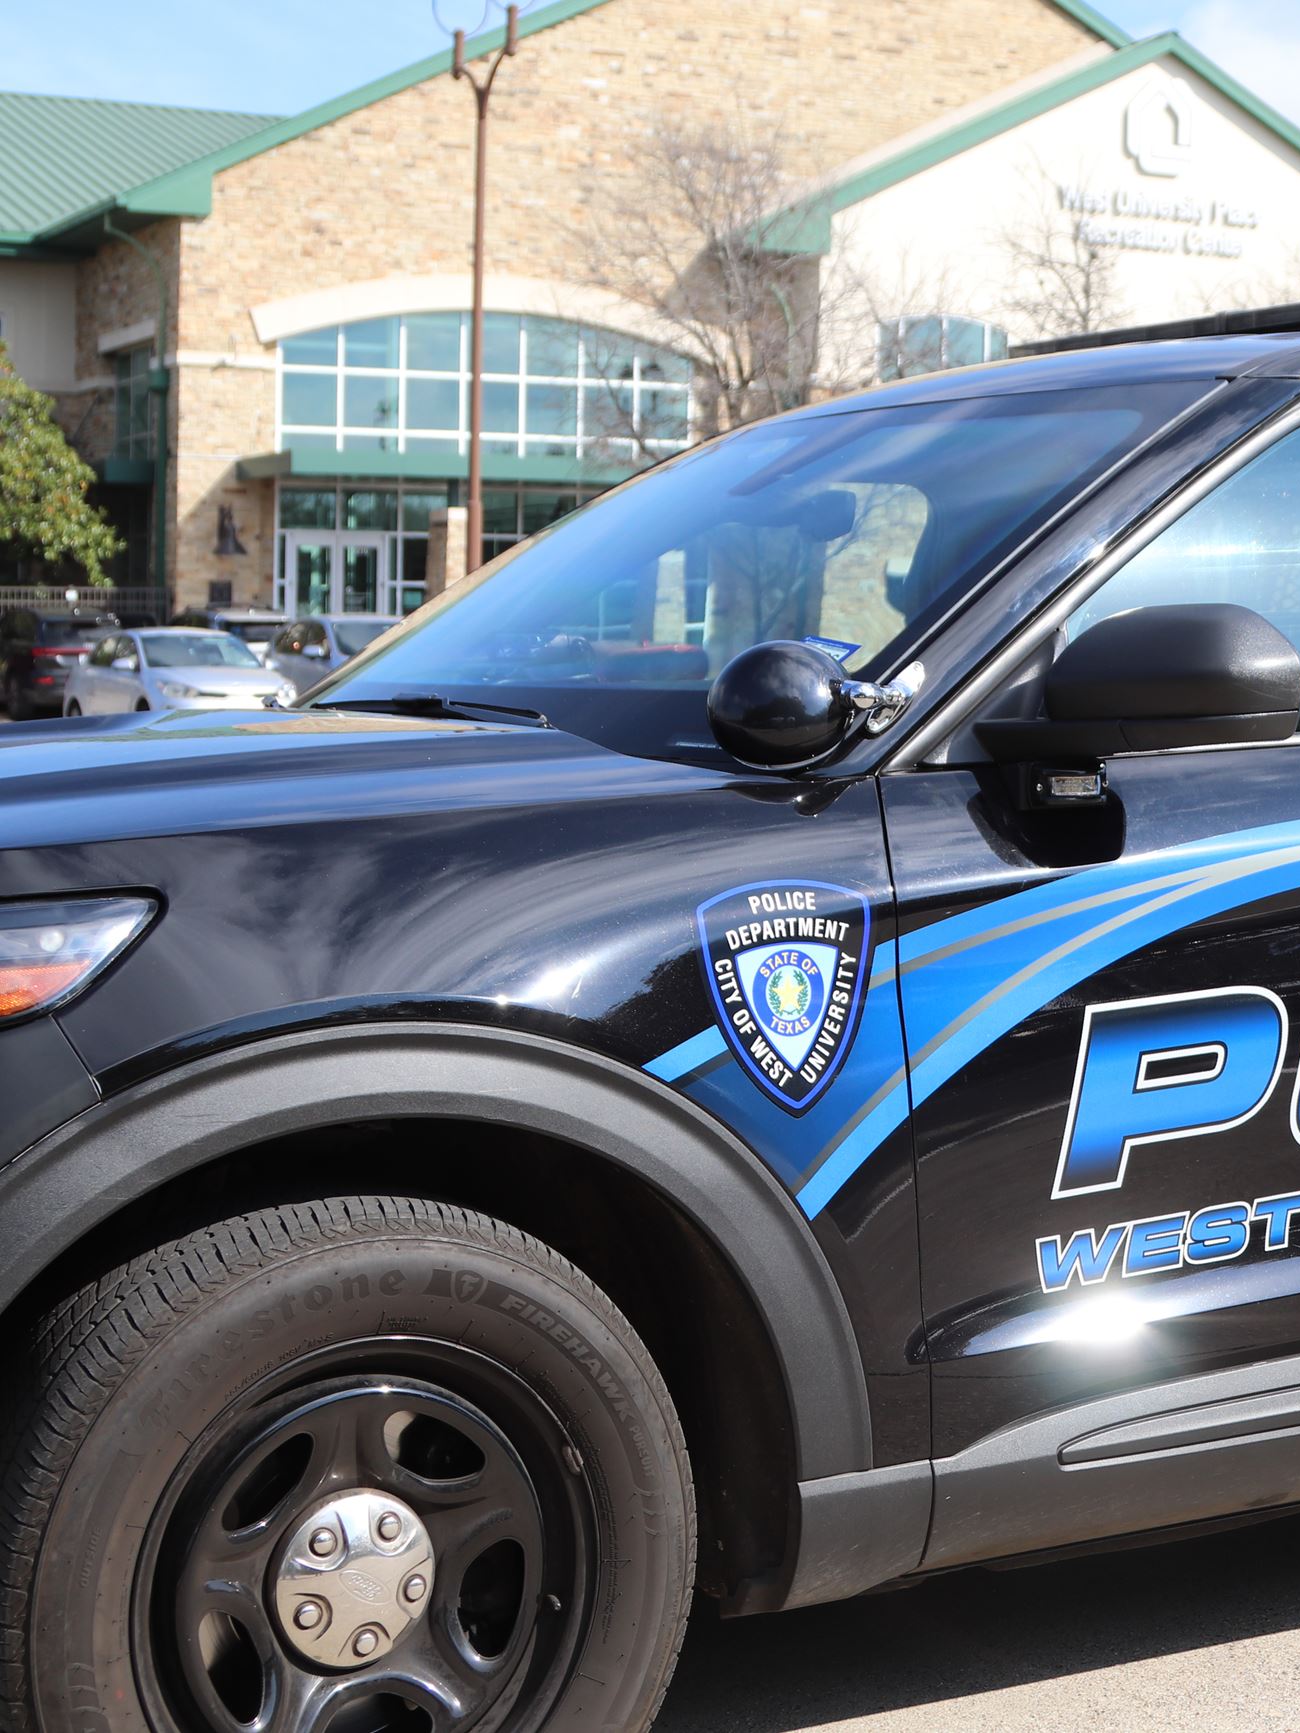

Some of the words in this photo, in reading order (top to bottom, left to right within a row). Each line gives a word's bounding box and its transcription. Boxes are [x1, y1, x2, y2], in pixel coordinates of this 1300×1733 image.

[1056, 184, 1107, 214] West
[1111, 188, 1201, 226] University
[1075, 216, 1178, 254] Recreation
[748, 891, 817, 914] POLICE
[725, 917, 850, 951] DEPARTMENT
[758, 951, 798, 978] STATE
[801, 958, 819, 976] OF
[714, 957, 742, 1004] CITY
[732, 1008, 757, 1035] OF
[750, 1035, 794, 1088] WEST
[799, 951, 857, 1084] UNIVERSITY
[769, 1015, 811, 1035] TEXAS
[500, 1294, 633, 1424] FIREHAWK
[629, 1425, 654, 1477] PURSUIT
